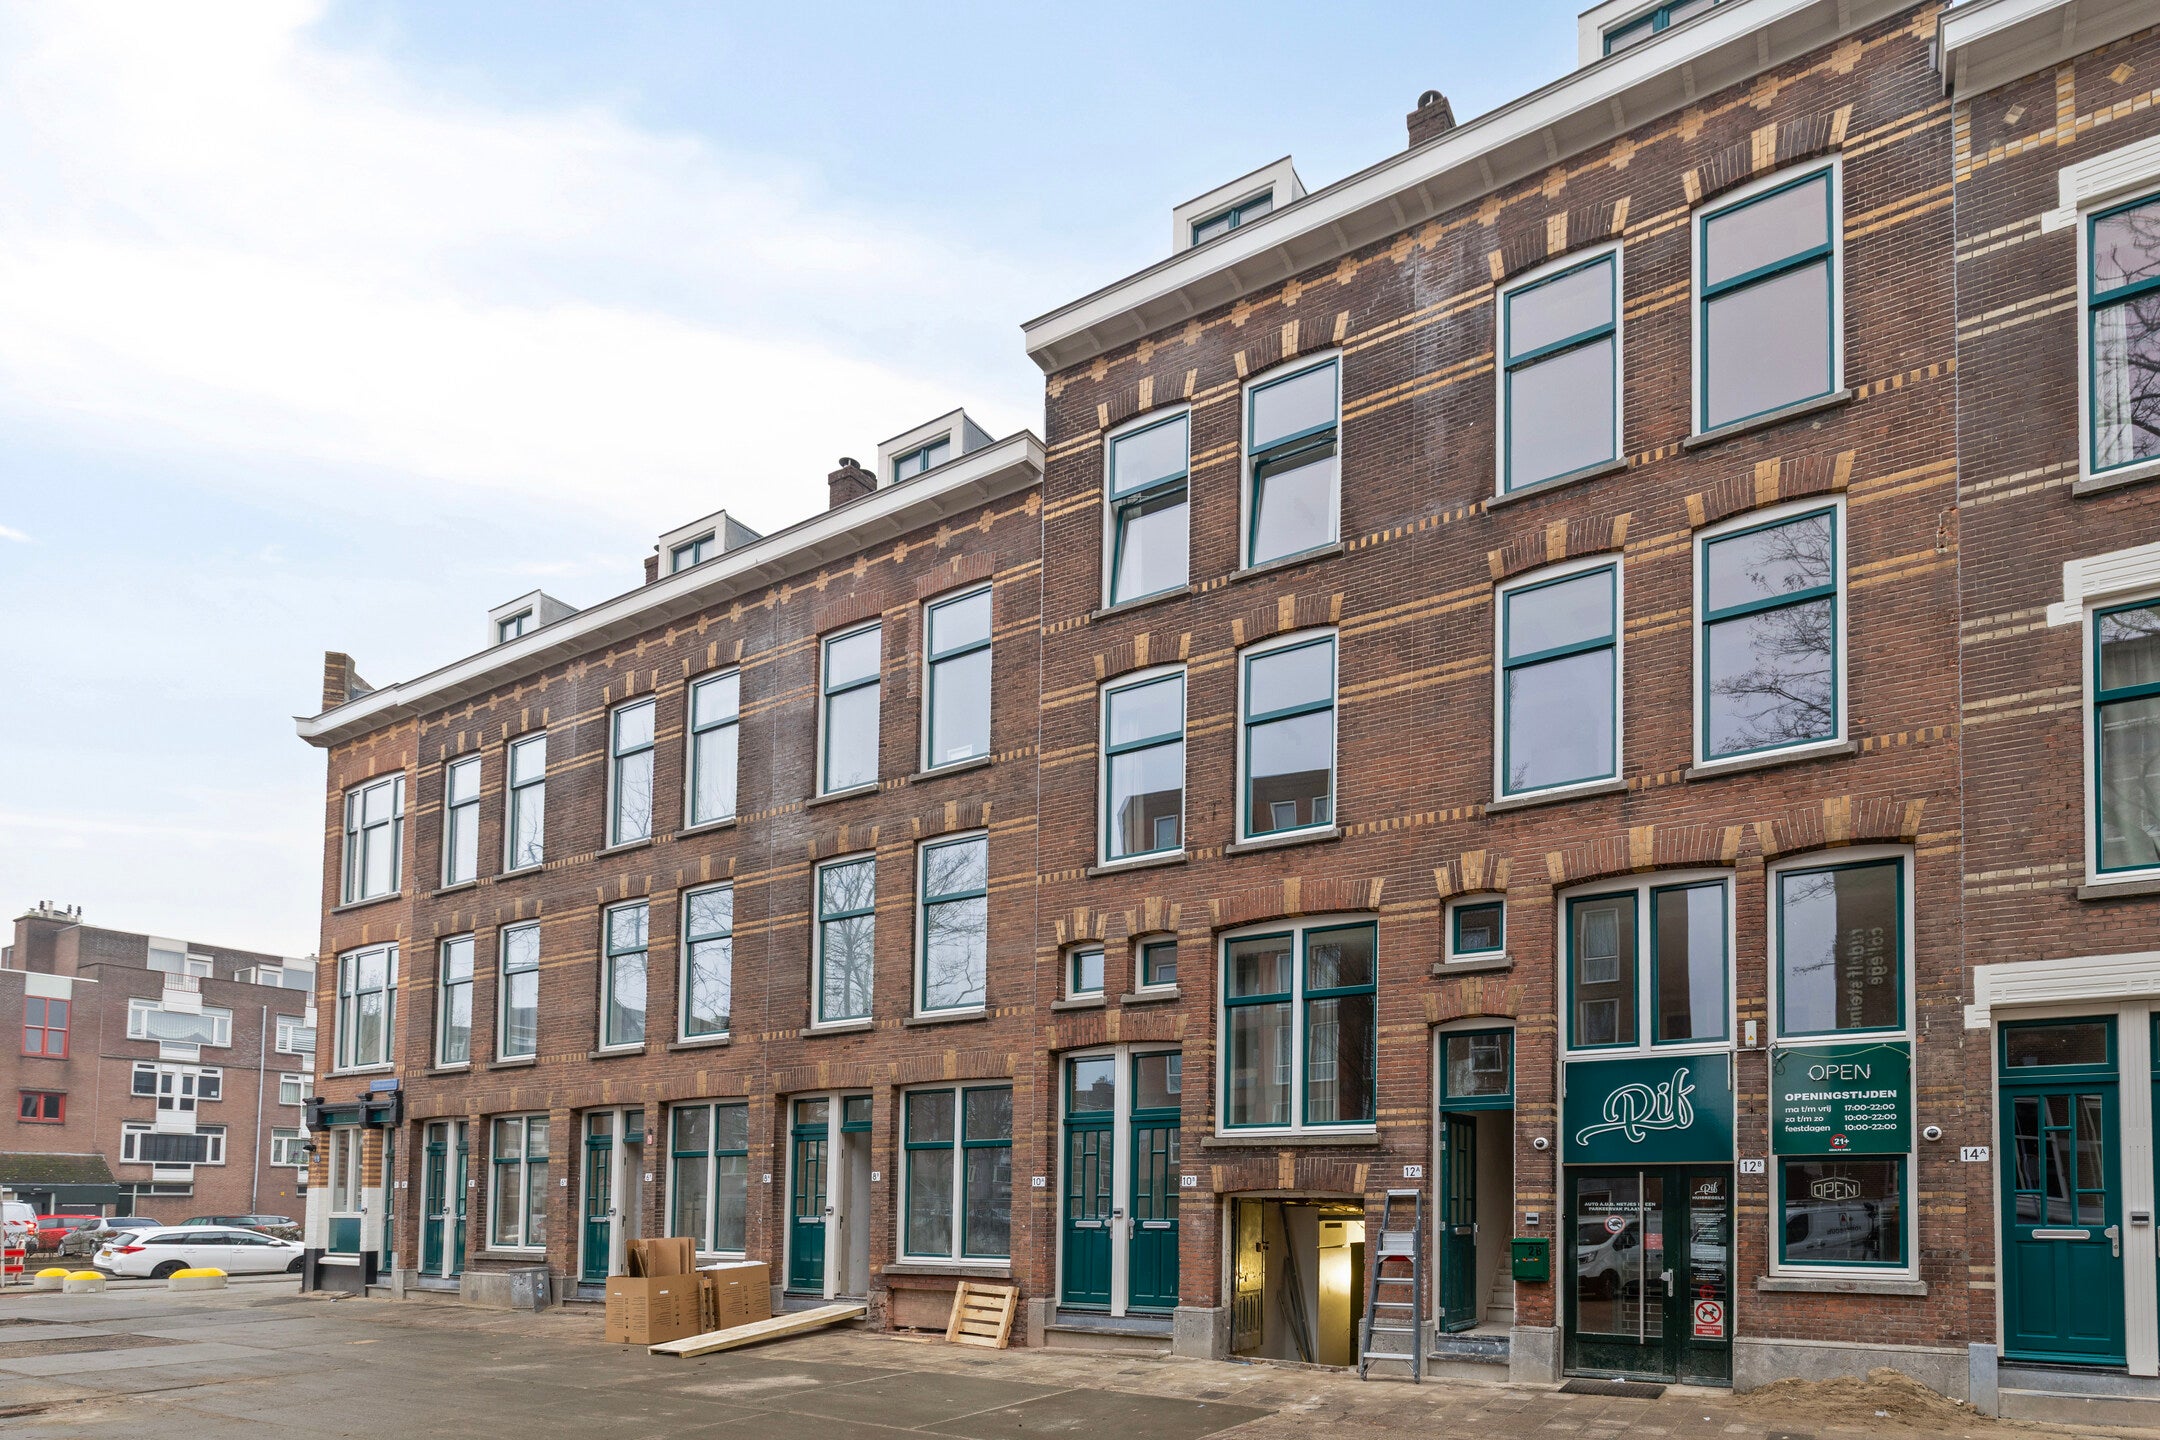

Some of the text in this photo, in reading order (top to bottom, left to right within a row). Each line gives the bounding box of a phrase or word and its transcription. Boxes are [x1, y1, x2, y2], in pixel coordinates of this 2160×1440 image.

[1808, 1064, 1871, 1081] OPEN
[1784, 1090, 1897, 1102] OPENINGSTIJDEN
[1576, 1067, 1695, 1146] Rif
[1801, 1105, 1816, 1113] t/m
[1818, 1104, 1832, 1113] vrij
[1844, 1103, 1896, 1112] 17:00-22:00
[1797, 1115, 1812, 1123] t/m
[1844, 1113, 1897, 1121] 10:00-22:00
[1785, 1123, 1897, 1133] feestdagen 10:00-22:00
[1963, 1148, 1986, 1160] 14A
[1405, 1166, 1420, 1177] 12A
[1694, 1181, 1718, 1195] Rif
[1813, 1182, 1856, 1199] OPEN
